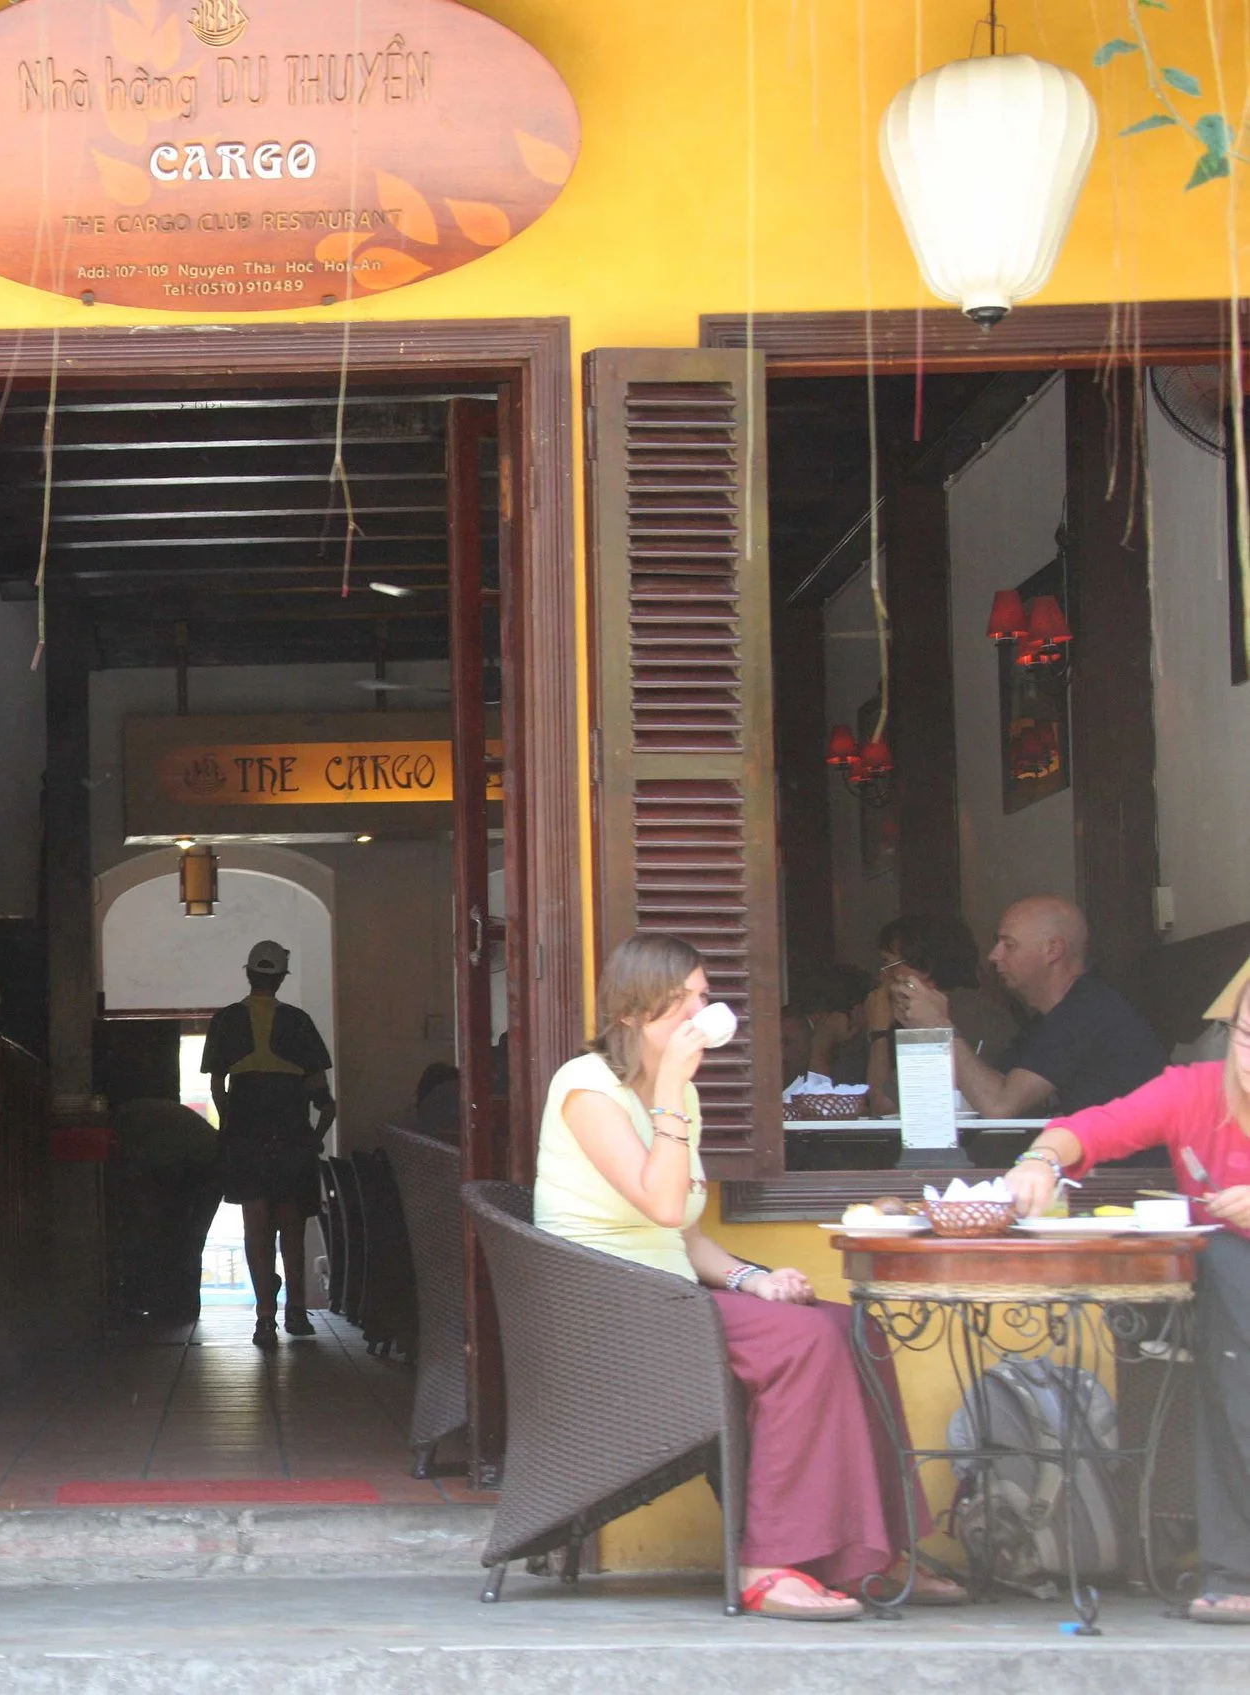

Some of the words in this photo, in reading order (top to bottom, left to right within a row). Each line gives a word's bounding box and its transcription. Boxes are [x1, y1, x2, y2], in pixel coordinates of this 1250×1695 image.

[215, 55, 269, 109] DU
[149, 142, 317, 181] CARGO
[62, 215, 106, 235] THE
[114, 212, 191, 234] CARGO
[197, 211, 252, 232] CLUB
[262, 208, 403, 231] RESTAURANT
[77, 265, 111, 279] Add:
[115, 264, 169, 278] 107-109
[234, 756, 300, 795] THE
[325, 754, 436, 790] CARGO
